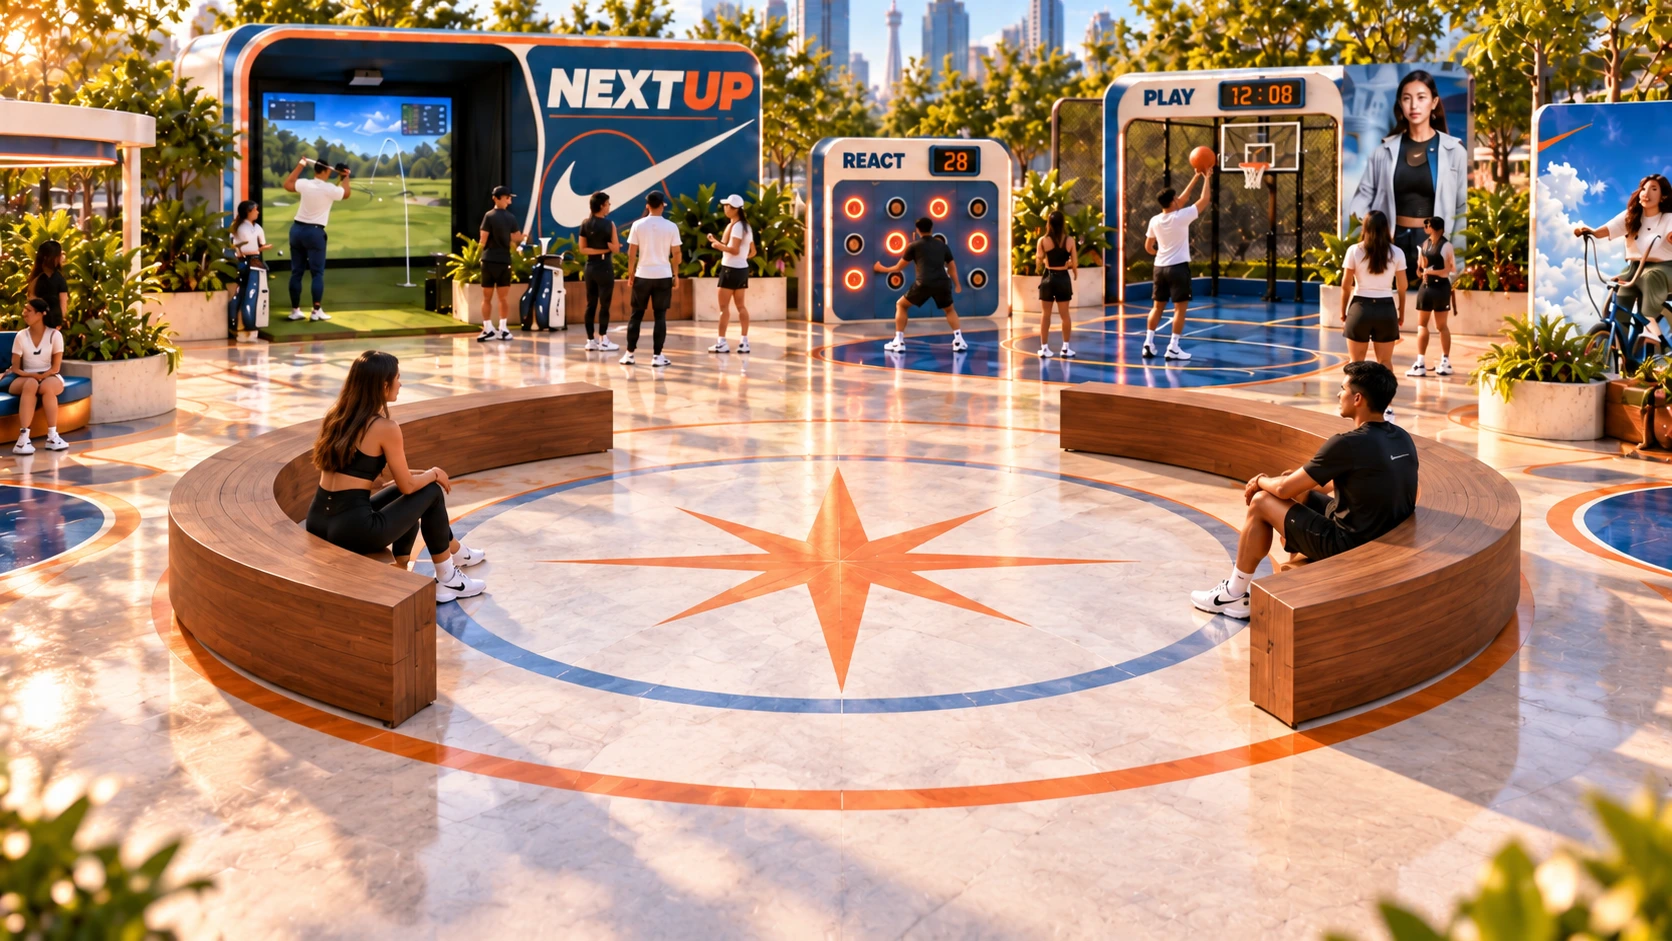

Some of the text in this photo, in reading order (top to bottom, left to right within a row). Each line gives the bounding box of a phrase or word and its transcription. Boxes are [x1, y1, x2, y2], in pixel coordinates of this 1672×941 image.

[1144, 88, 1195, 106] PLAY
[843, 152, 905, 169] REACT
[944, 151, 968, 171] 28
